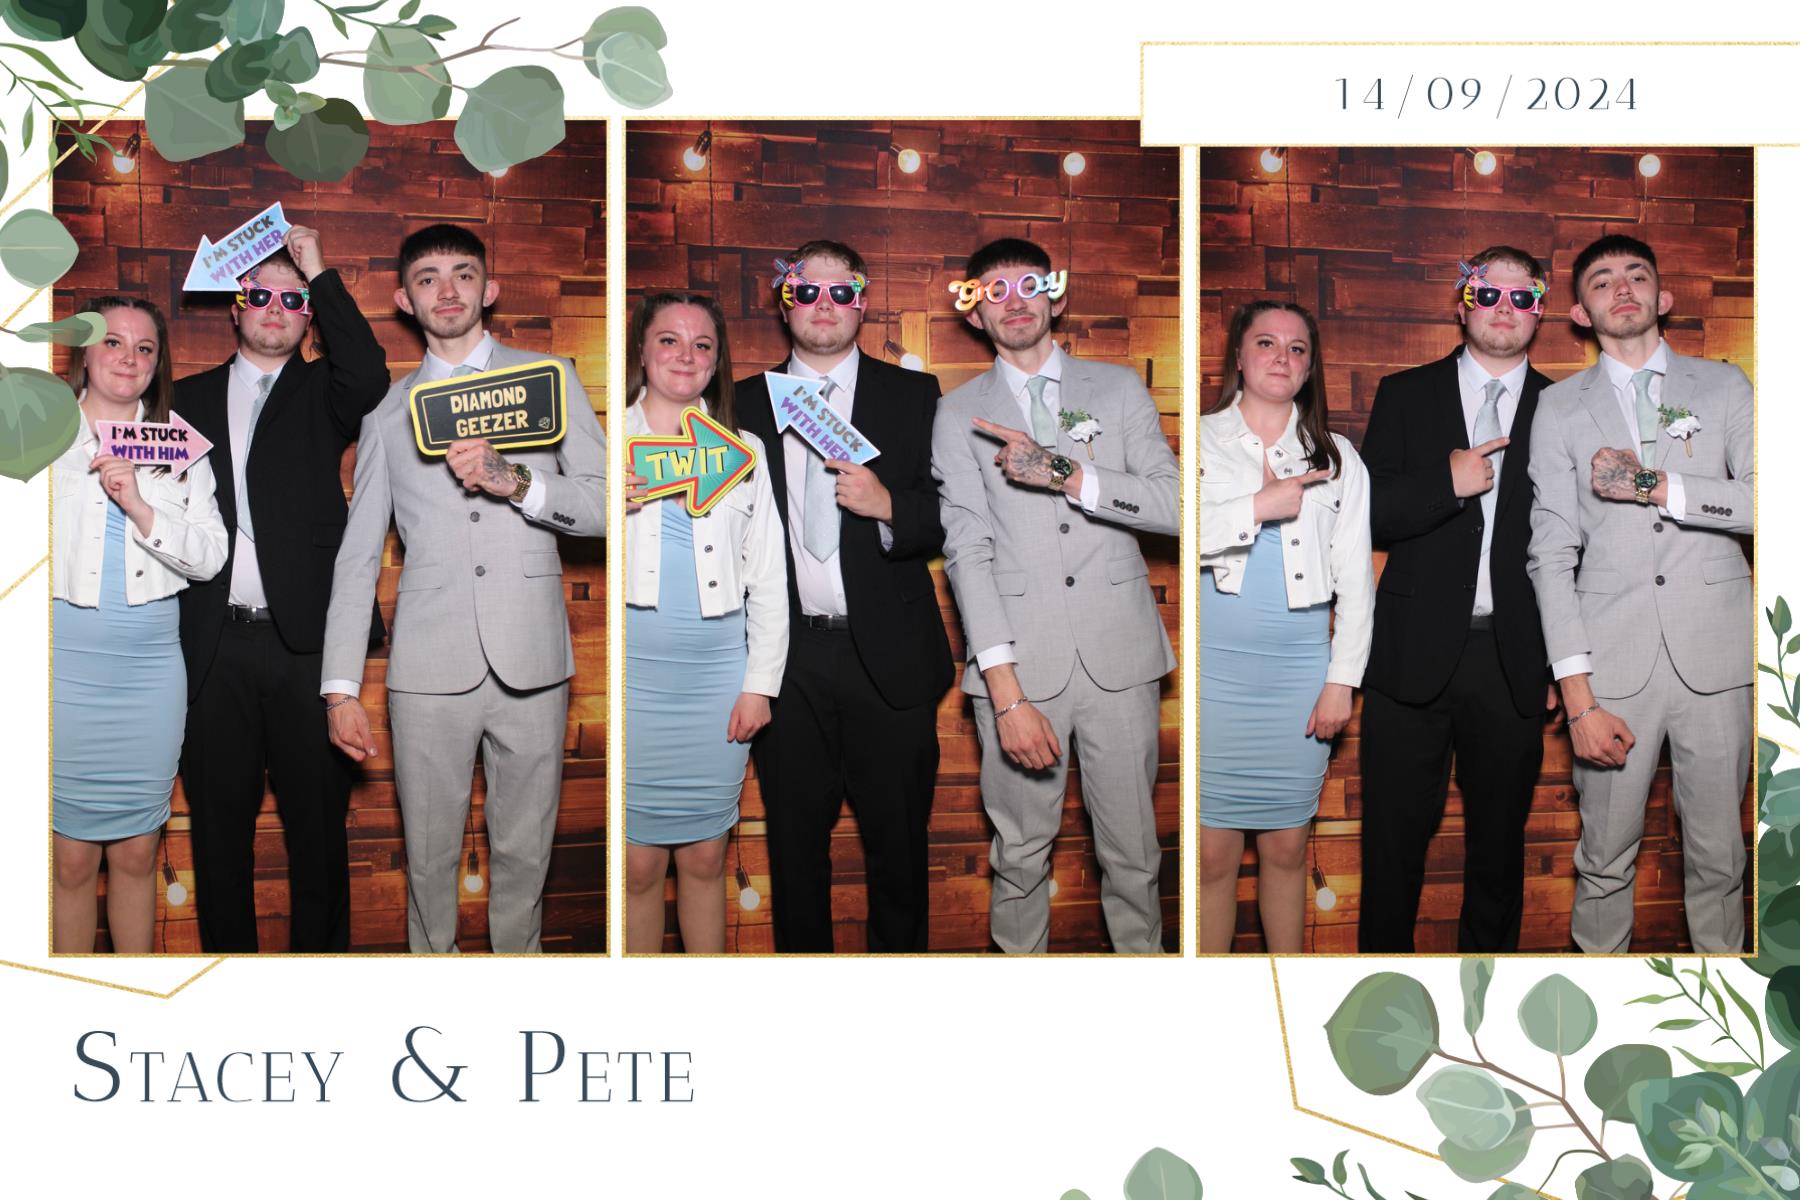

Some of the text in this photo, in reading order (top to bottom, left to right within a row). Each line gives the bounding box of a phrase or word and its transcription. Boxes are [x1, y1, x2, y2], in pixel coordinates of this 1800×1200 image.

[203, 215, 274, 269] I'M STUCK
[210, 229, 284, 283] WITH HER
[450, 385, 527, 414] DIAMOND
[780, 396, 823, 439] WITH
[112, 426, 188, 442] I'M STUCK
[455, 409, 529, 437] GEEZER
[793, 385, 863, 453] I'M STUCK
[111, 444, 189, 461] WITH HIM
[645, 445, 729, 481] TWIT
